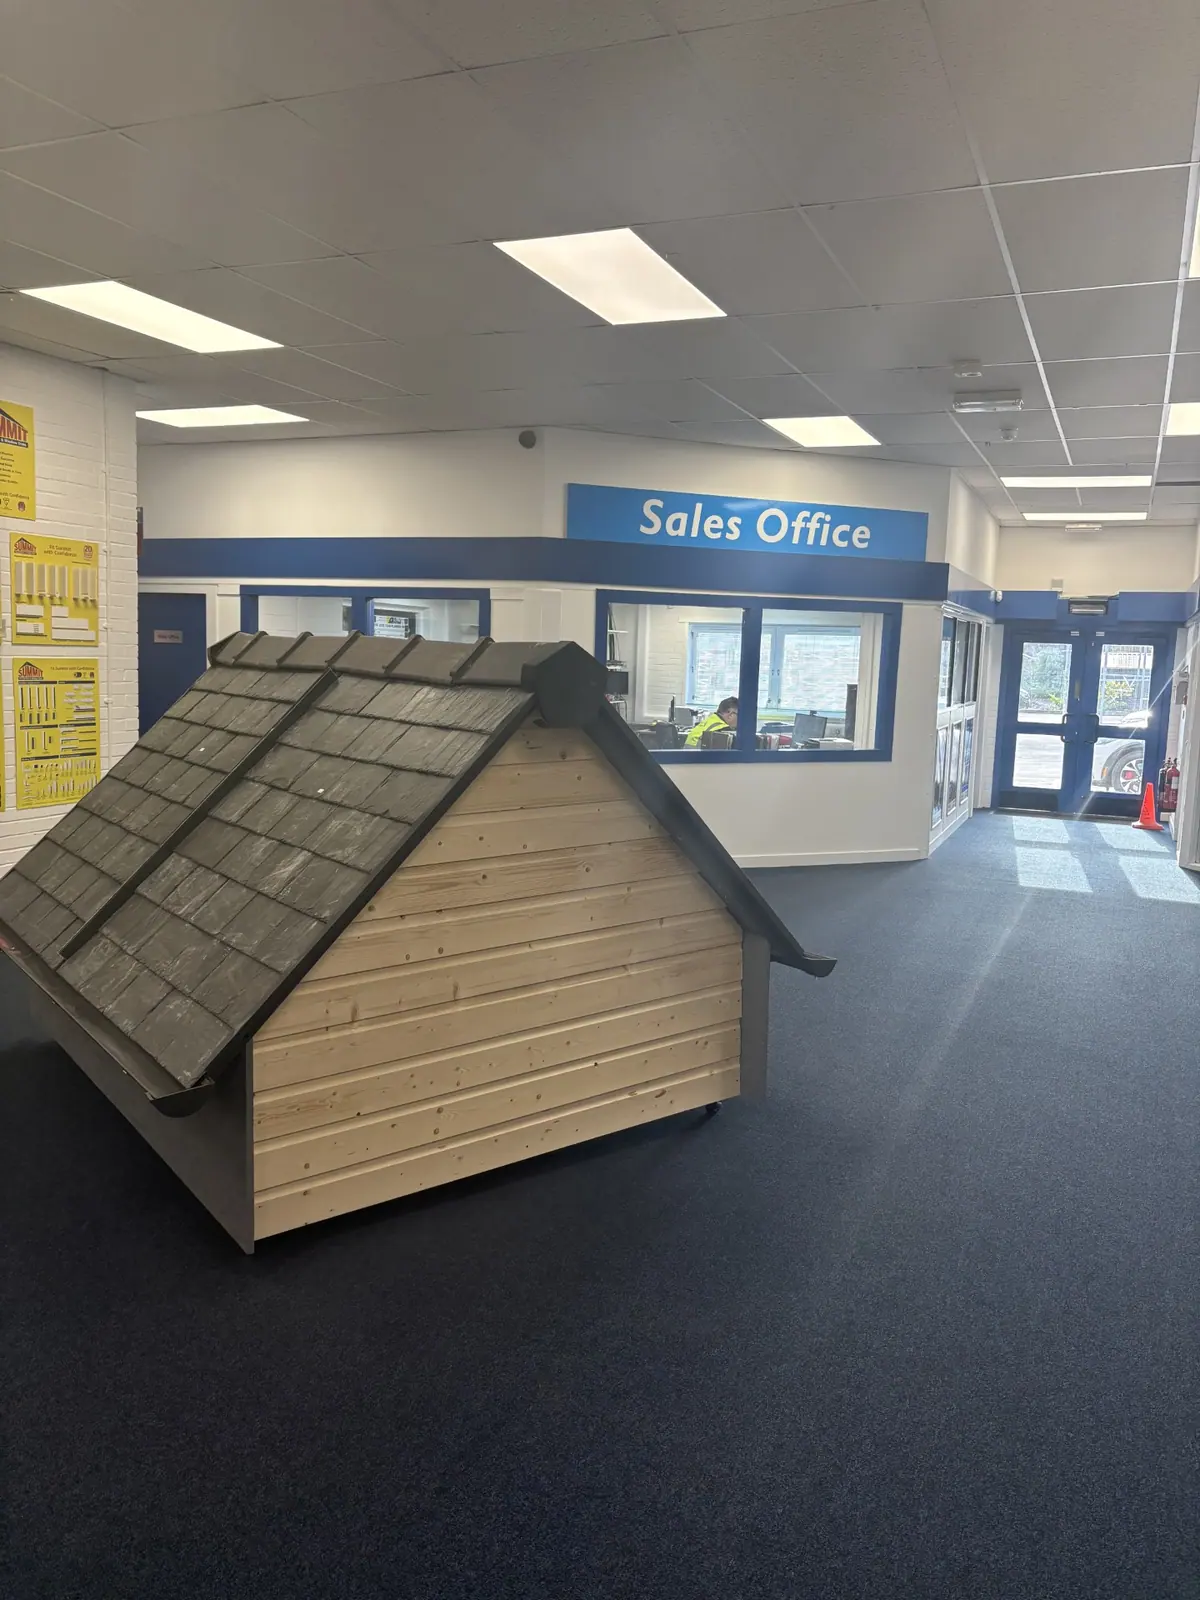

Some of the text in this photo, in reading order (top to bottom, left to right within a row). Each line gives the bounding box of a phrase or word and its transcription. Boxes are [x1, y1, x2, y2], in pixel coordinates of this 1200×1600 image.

[639, 498, 871, 549] Sales Office
[18, 664, 44, 678] SUMMIT
